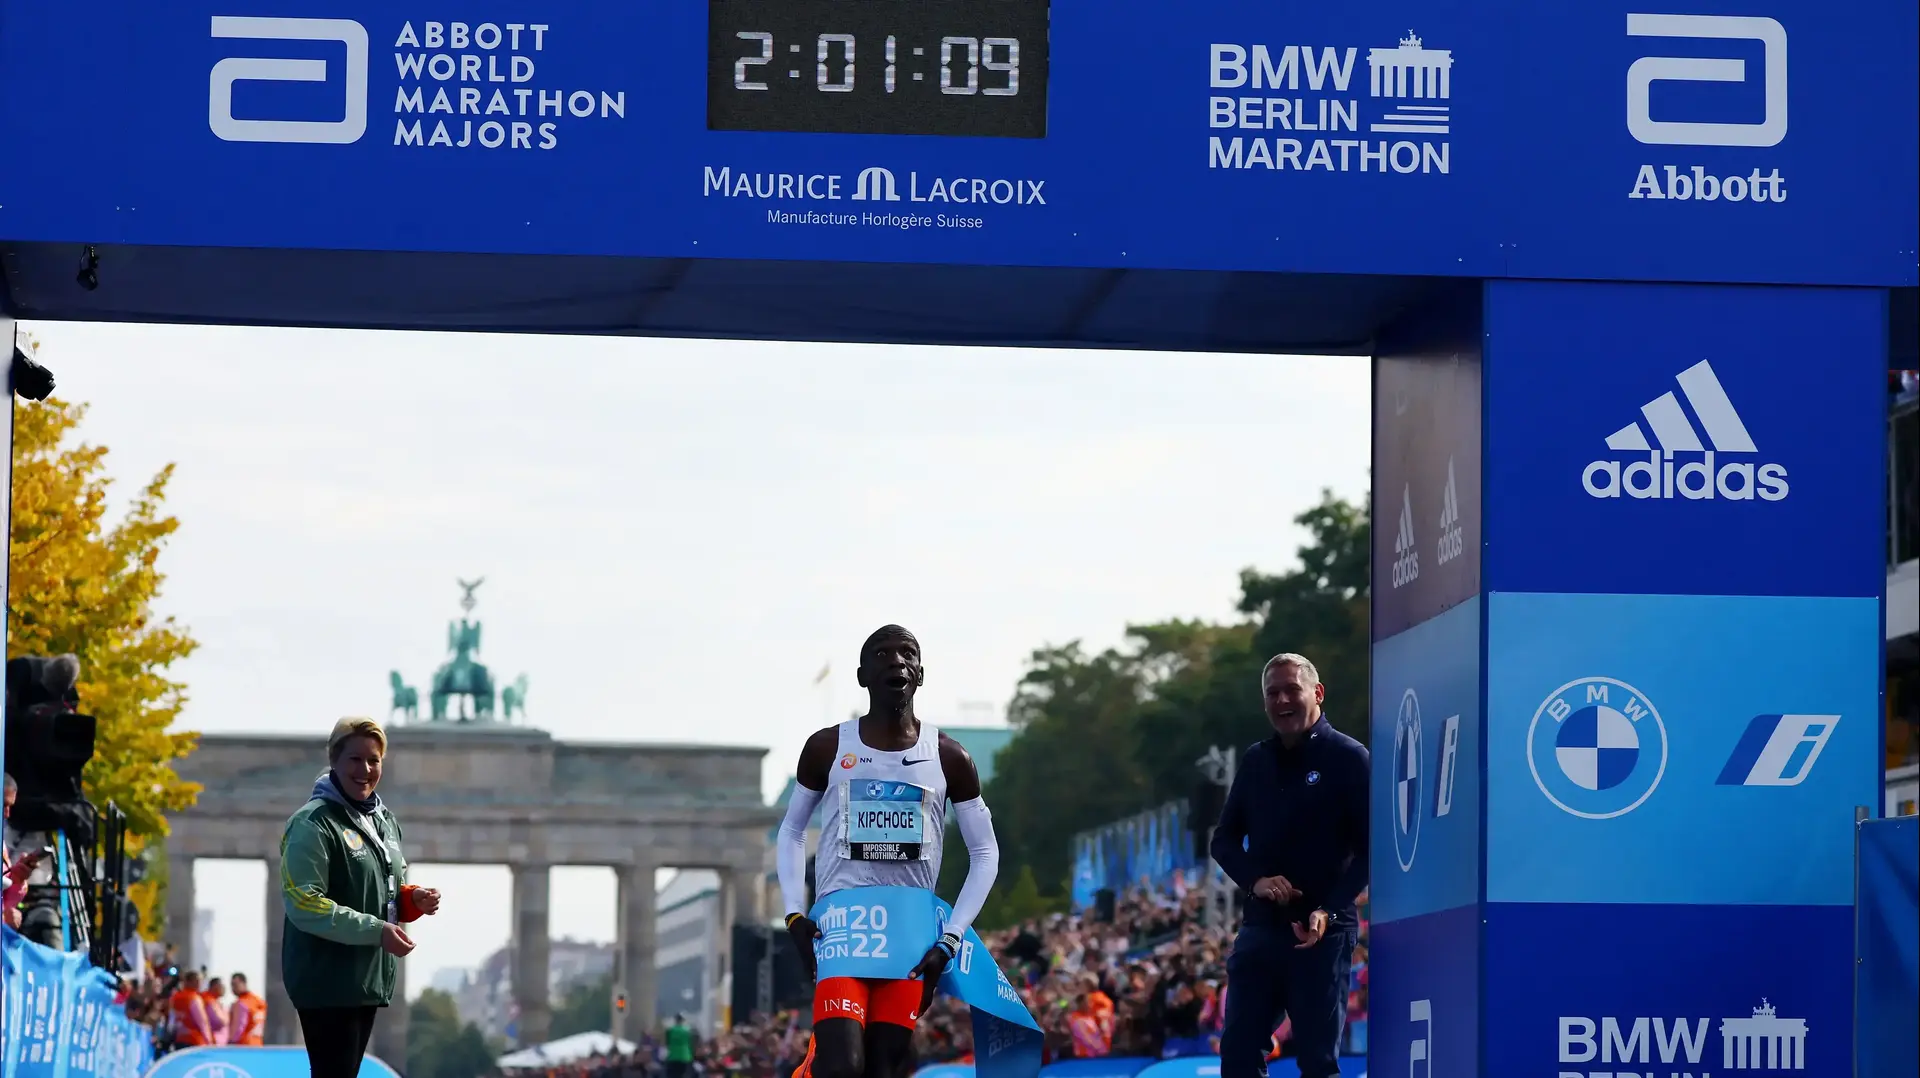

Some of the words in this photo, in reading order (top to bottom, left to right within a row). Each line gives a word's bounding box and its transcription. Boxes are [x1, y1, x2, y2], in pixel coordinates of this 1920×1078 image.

[395, 21, 548, 51] ABBOTT
[395, 53, 534, 82] WORLD
[734, 32, 1020, 96] 2:01:09
[1209, 44, 1357, 91] BMW
[394, 86, 625, 119] MARATHON
[1209, 97, 1357, 131] BERLIN
[394, 120, 557, 149] MAJORS
[1209, 137, 1450, 173] MARATHON
[703, 166, 841, 200] MAURICE
[911, 172, 1046, 204] LACROIX
[1628, 165, 1787, 202] Abbott
[767, 210, 857, 225] Manufacture
[862, 212, 932, 230] Horlogère
[937, 214, 983, 229] Suisse
[1582, 449, 1789, 501] adidas
[1547, 684, 1649, 723] BMW
[858, 811, 914, 828] KIPCHOGE
[862, 844, 900, 852] IMPOSSIBLE
[863, 852, 870, 860] IS
[850, 905, 888, 931] 20
[851, 933, 889, 958] 22
[824, 999, 864, 1019] INEOS
[1558, 1016, 1710, 1064] BMW
